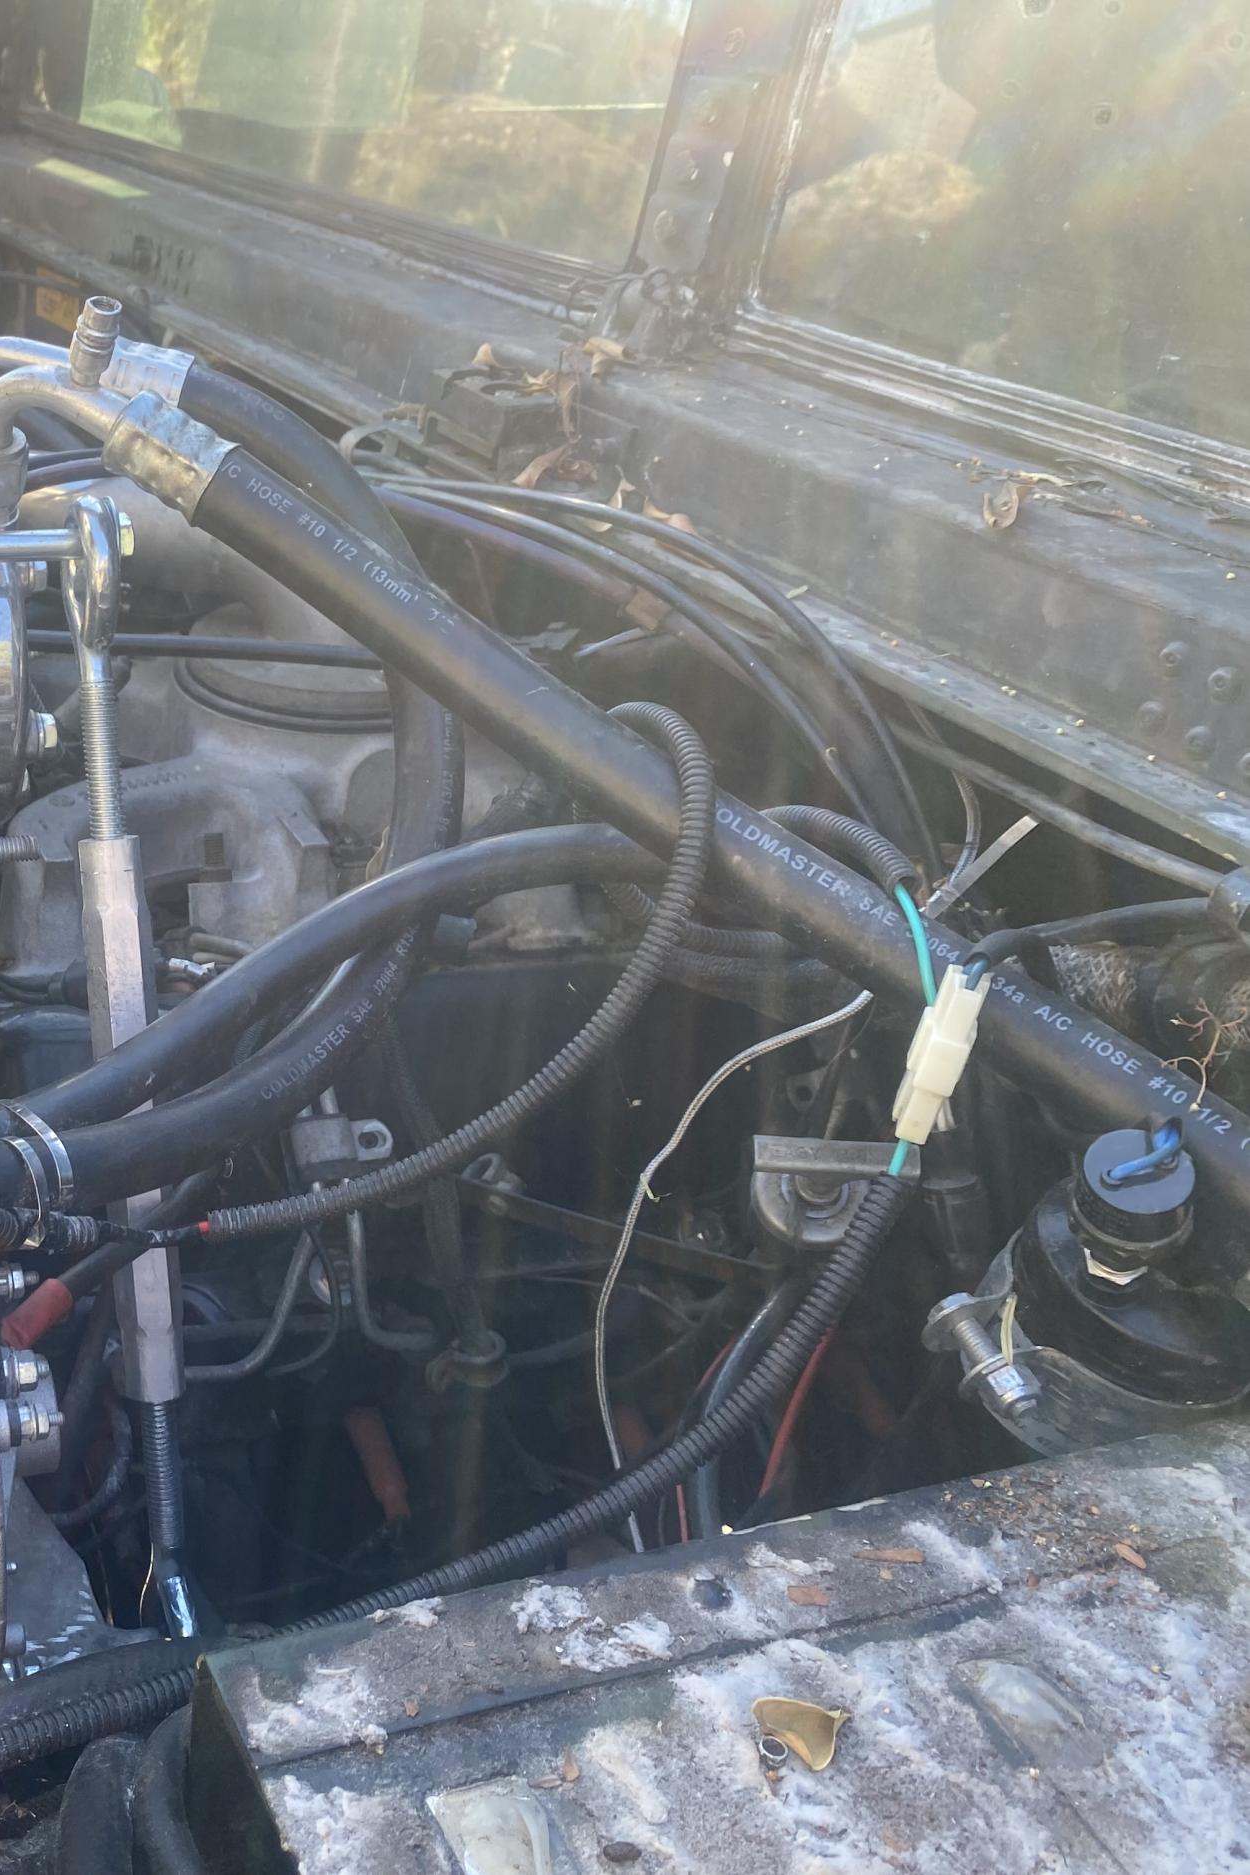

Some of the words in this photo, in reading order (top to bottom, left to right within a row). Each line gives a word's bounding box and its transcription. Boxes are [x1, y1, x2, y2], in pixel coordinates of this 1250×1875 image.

[221, 460, 241, 478] /C
[246, 478, 293, 514] HOSE
[297, 512, 326, 538] #10
[332, 538, 358, 561] 1/2
[260, 1023, 351, 1100] COLDMASTER
[351, 999, 374, 1024] SAE
[373, 960, 399, 997] J2064
[715, 807, 852, 897] OLDMASTER
[859, 896, 897, 927] SAE
[906, 922, 960, 962] 064
[991, 976, 1025, 1004] 34a
[1033, 1004, 1073, 1032] A/C
[1080, 1031, 1143, 1076] HOSE
[1147, 1075, 1188, 1105] #10
[1197, 1107, 1232, 1135] 1/2
